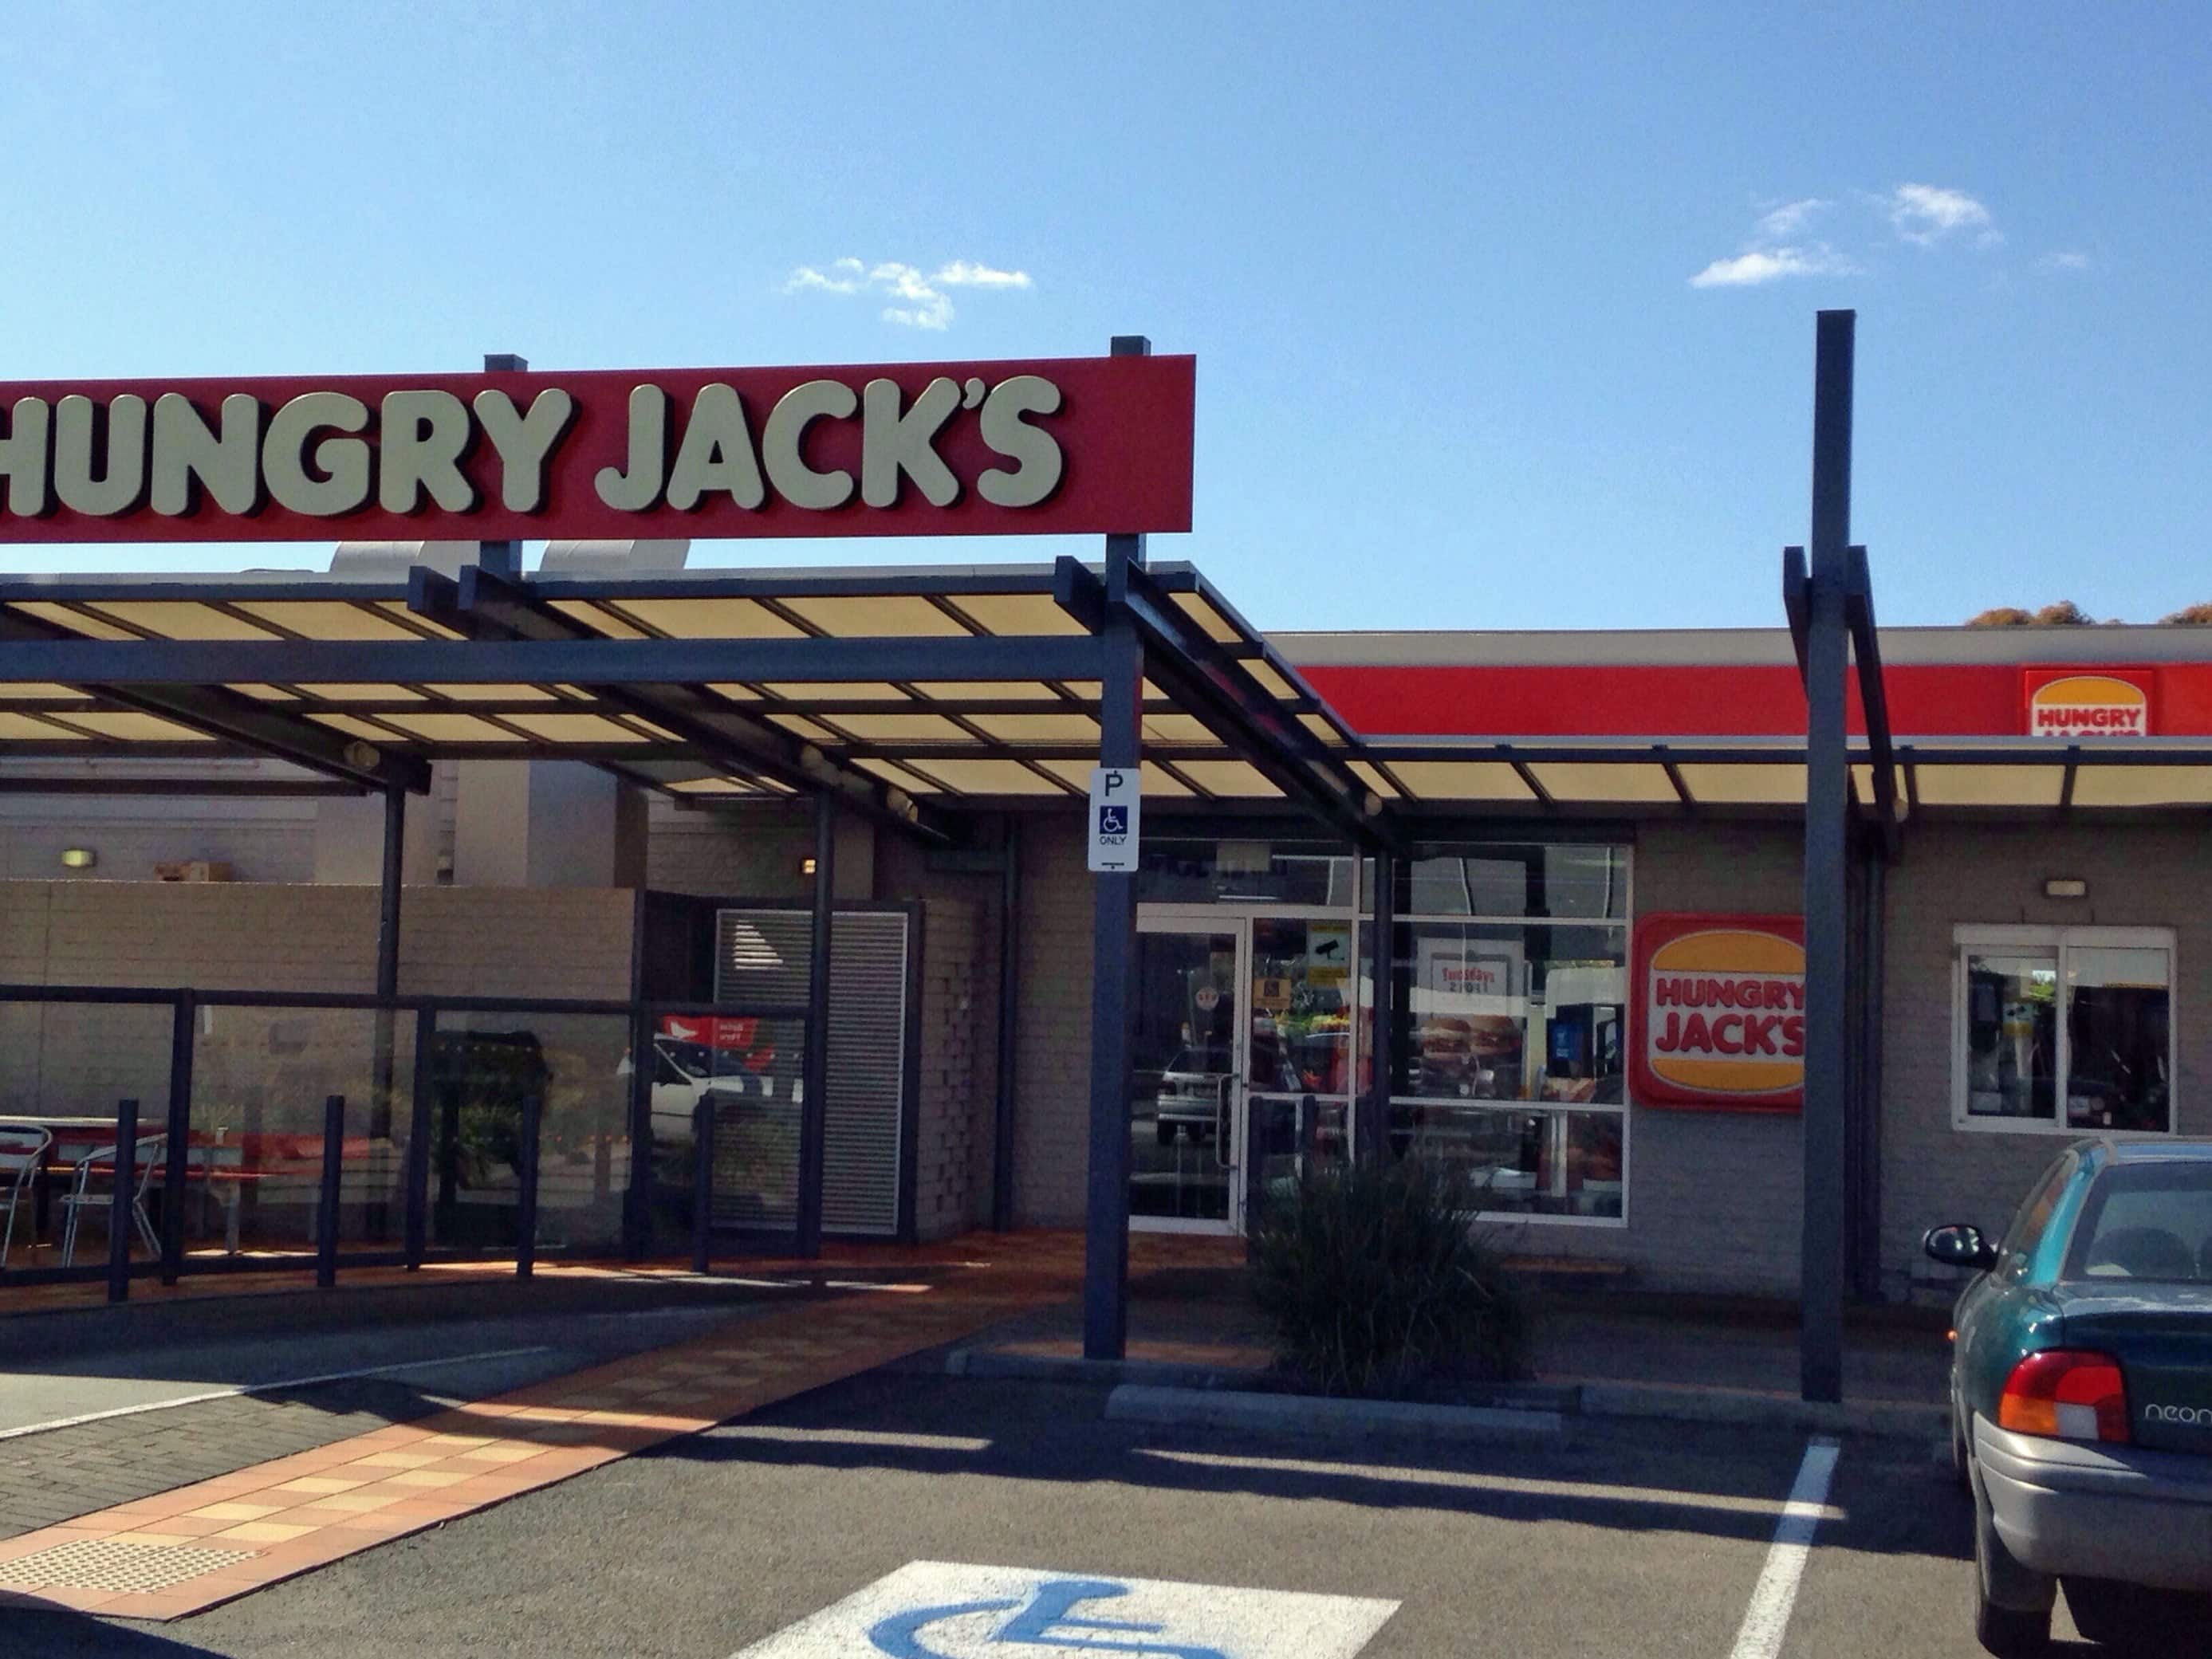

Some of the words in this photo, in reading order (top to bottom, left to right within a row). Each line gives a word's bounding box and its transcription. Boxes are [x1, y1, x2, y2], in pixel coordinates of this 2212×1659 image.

[594, 375, 1062, 510] JACK'S
[2037, 708, 2141, 727] HUNGRY
[1104, 773, 1124, 796] P
[1099, 835, 1128, 846] ONLY
[1655, 977, 1805, 1009] HUNGRY
[1655, 1012, 1805, 1057] JACK'S
[2144, 1403, 2212, 1423] neon
